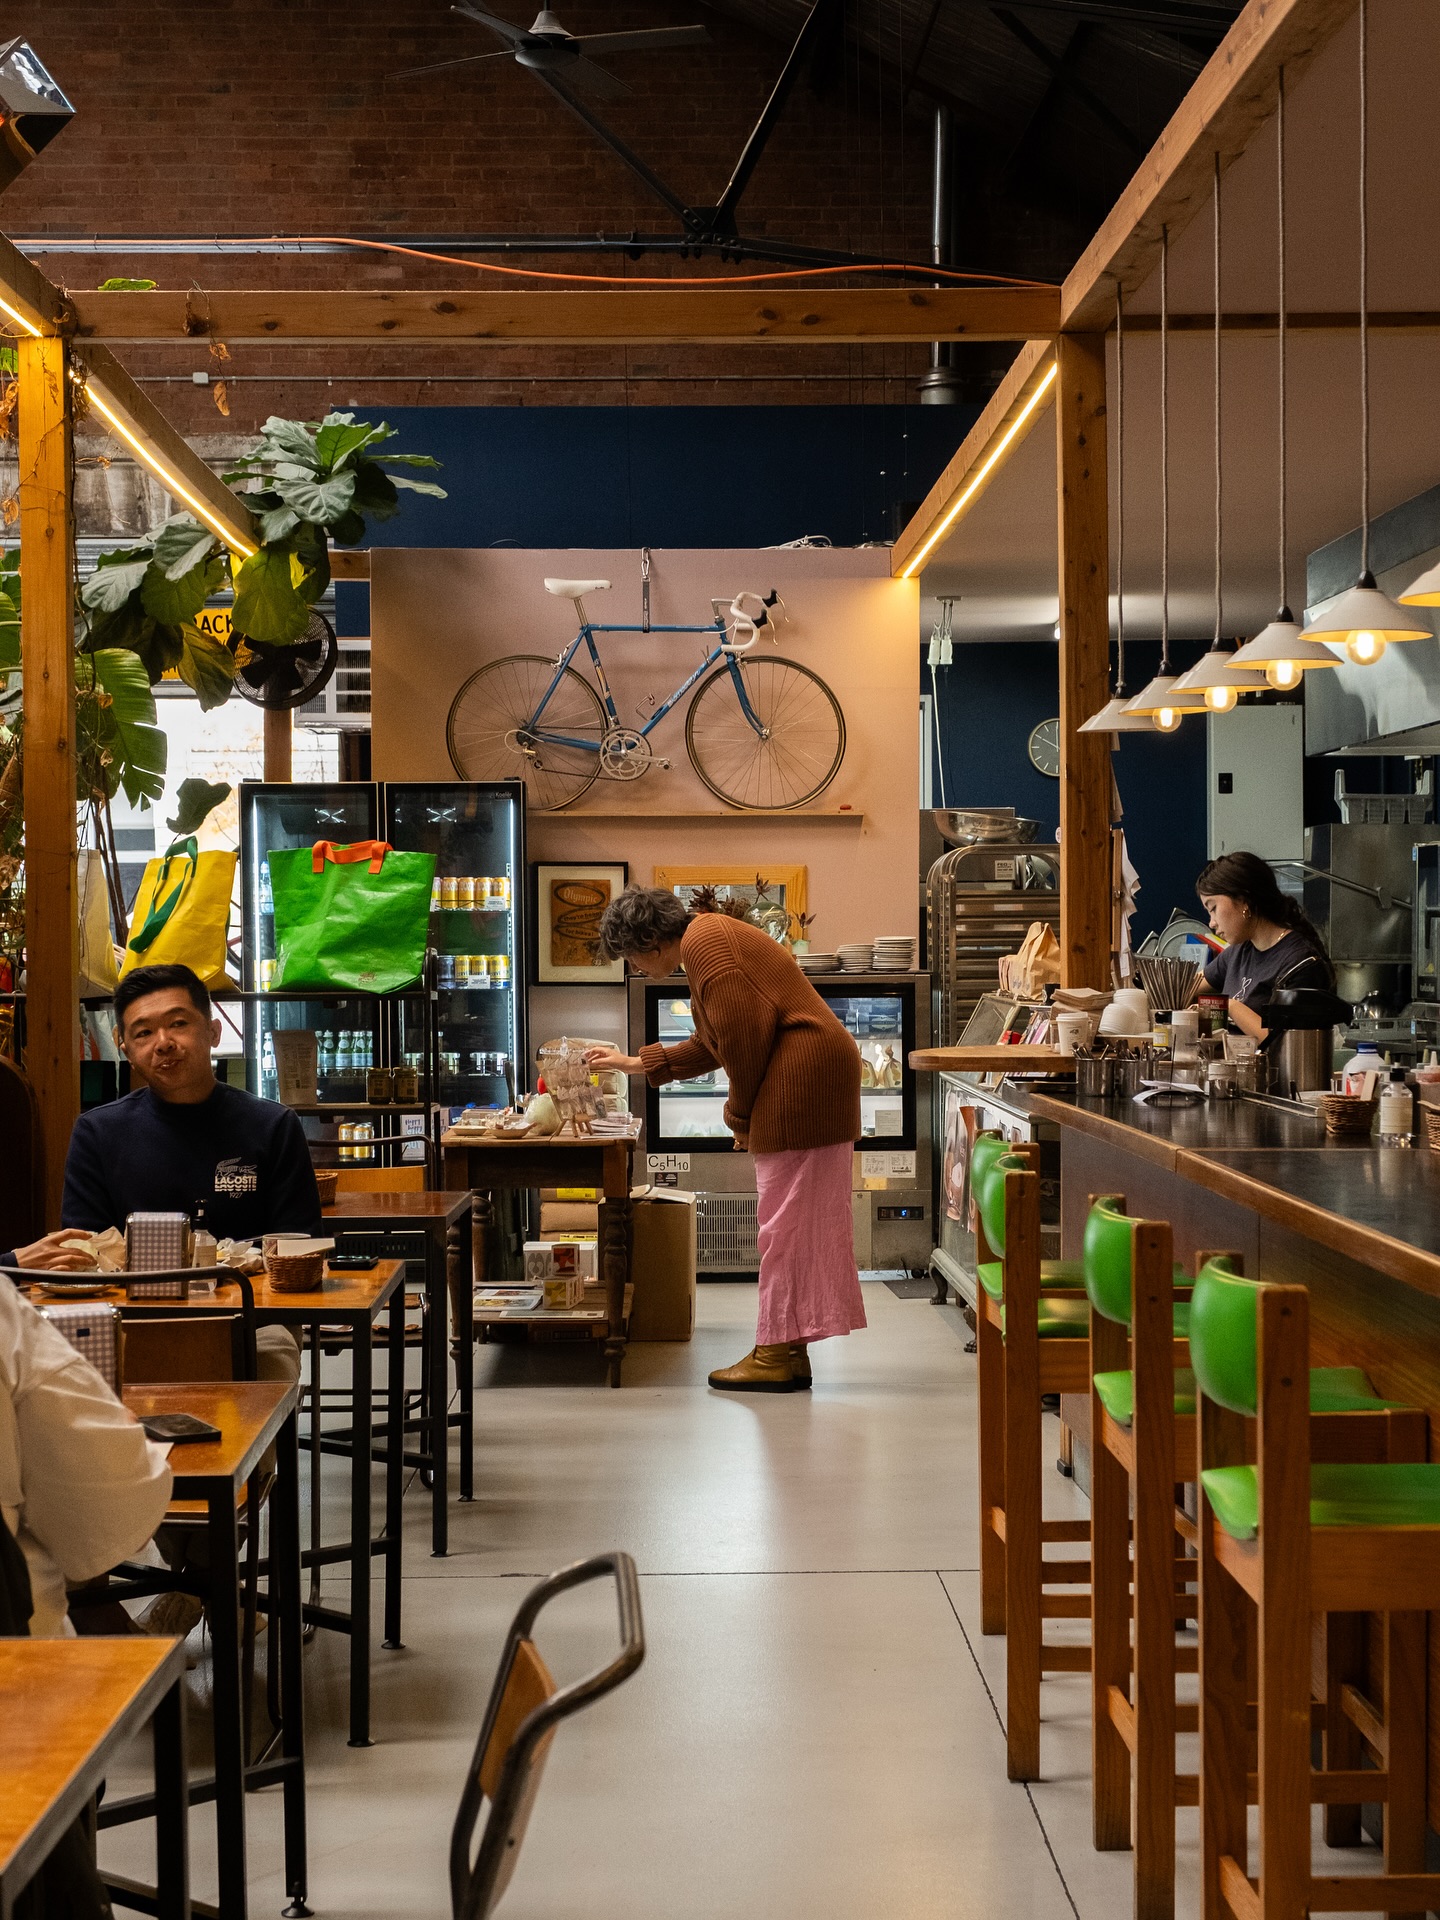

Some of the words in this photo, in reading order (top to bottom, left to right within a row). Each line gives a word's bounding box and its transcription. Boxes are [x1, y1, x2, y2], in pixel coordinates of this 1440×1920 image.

[194, 614, 233, 634] ACK
[563, 887, 598, 904] Olympic
[214, 1175, 257, 1188] LACOSTE
